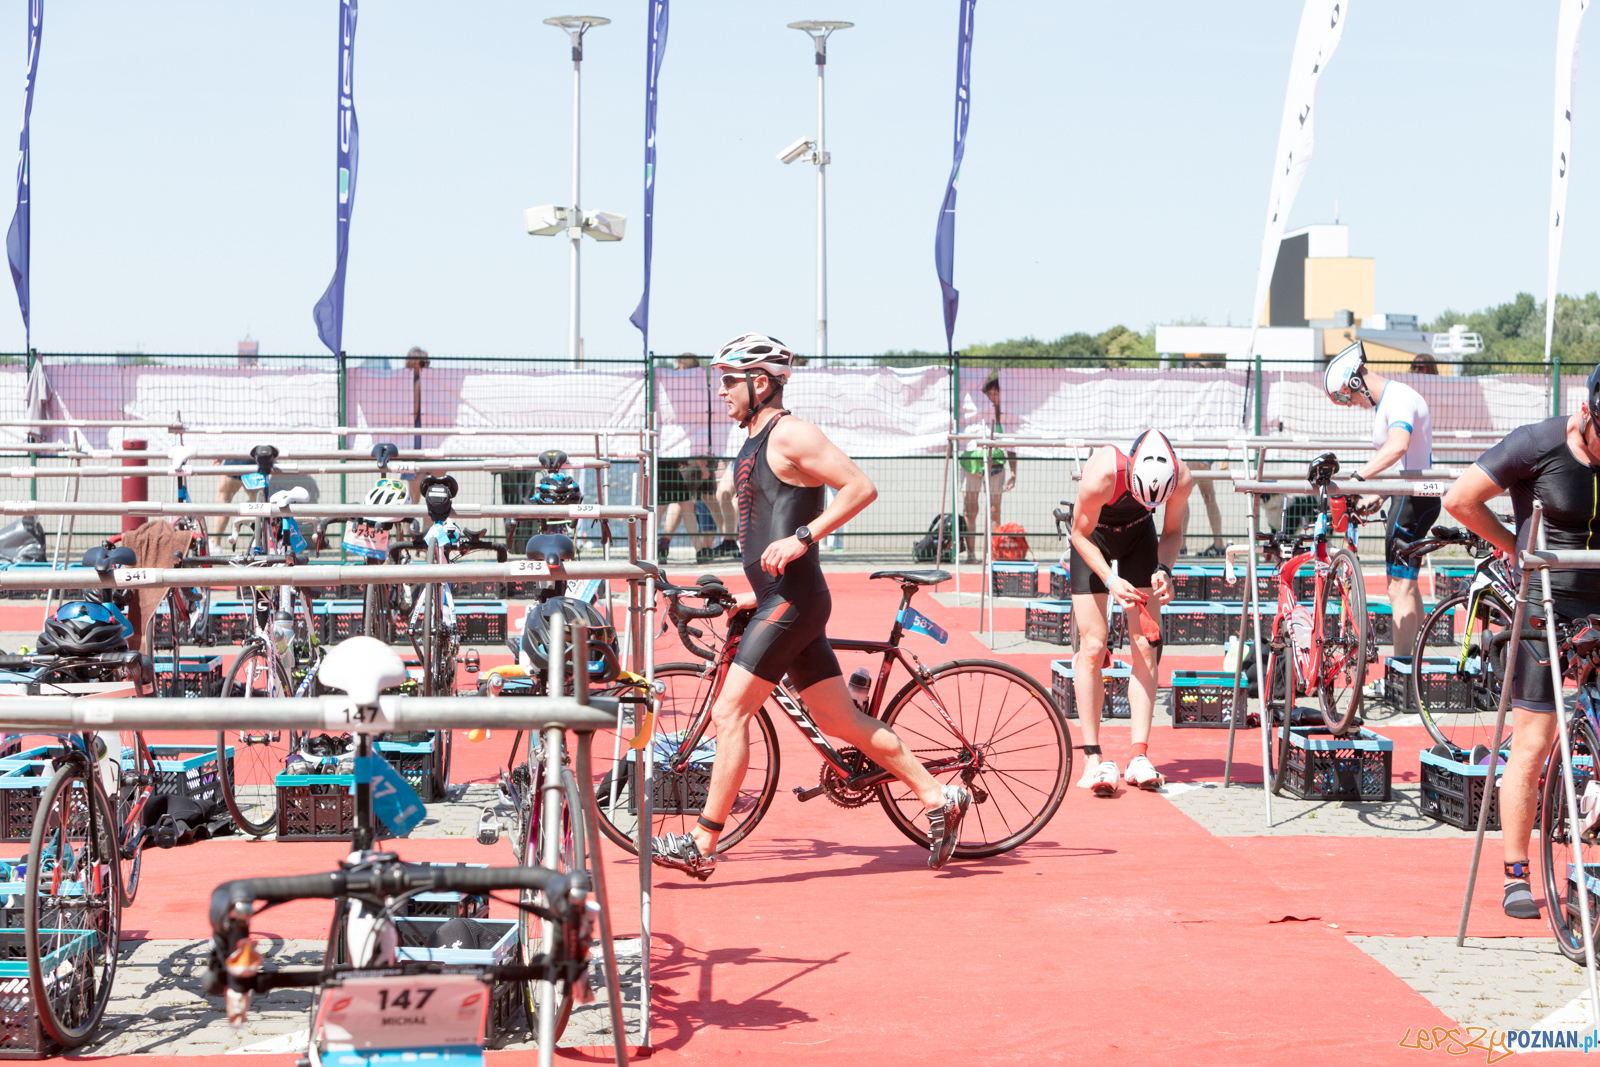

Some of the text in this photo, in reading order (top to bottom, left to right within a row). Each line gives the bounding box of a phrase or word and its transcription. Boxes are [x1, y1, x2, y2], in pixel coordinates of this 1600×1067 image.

[247, 503, 265, 511] 537
[576, 503, 594, 512] 539
[357, 528, 376, 539] 733
[519, 561, 543, 571] 343
[125, 569, 147, 582] 341
[913, 615, 935, 632] 587
[342, 706, 379, 723] 147
[766, 684, 831, 750] OTT
[378, 987, 437, 1011] 147
